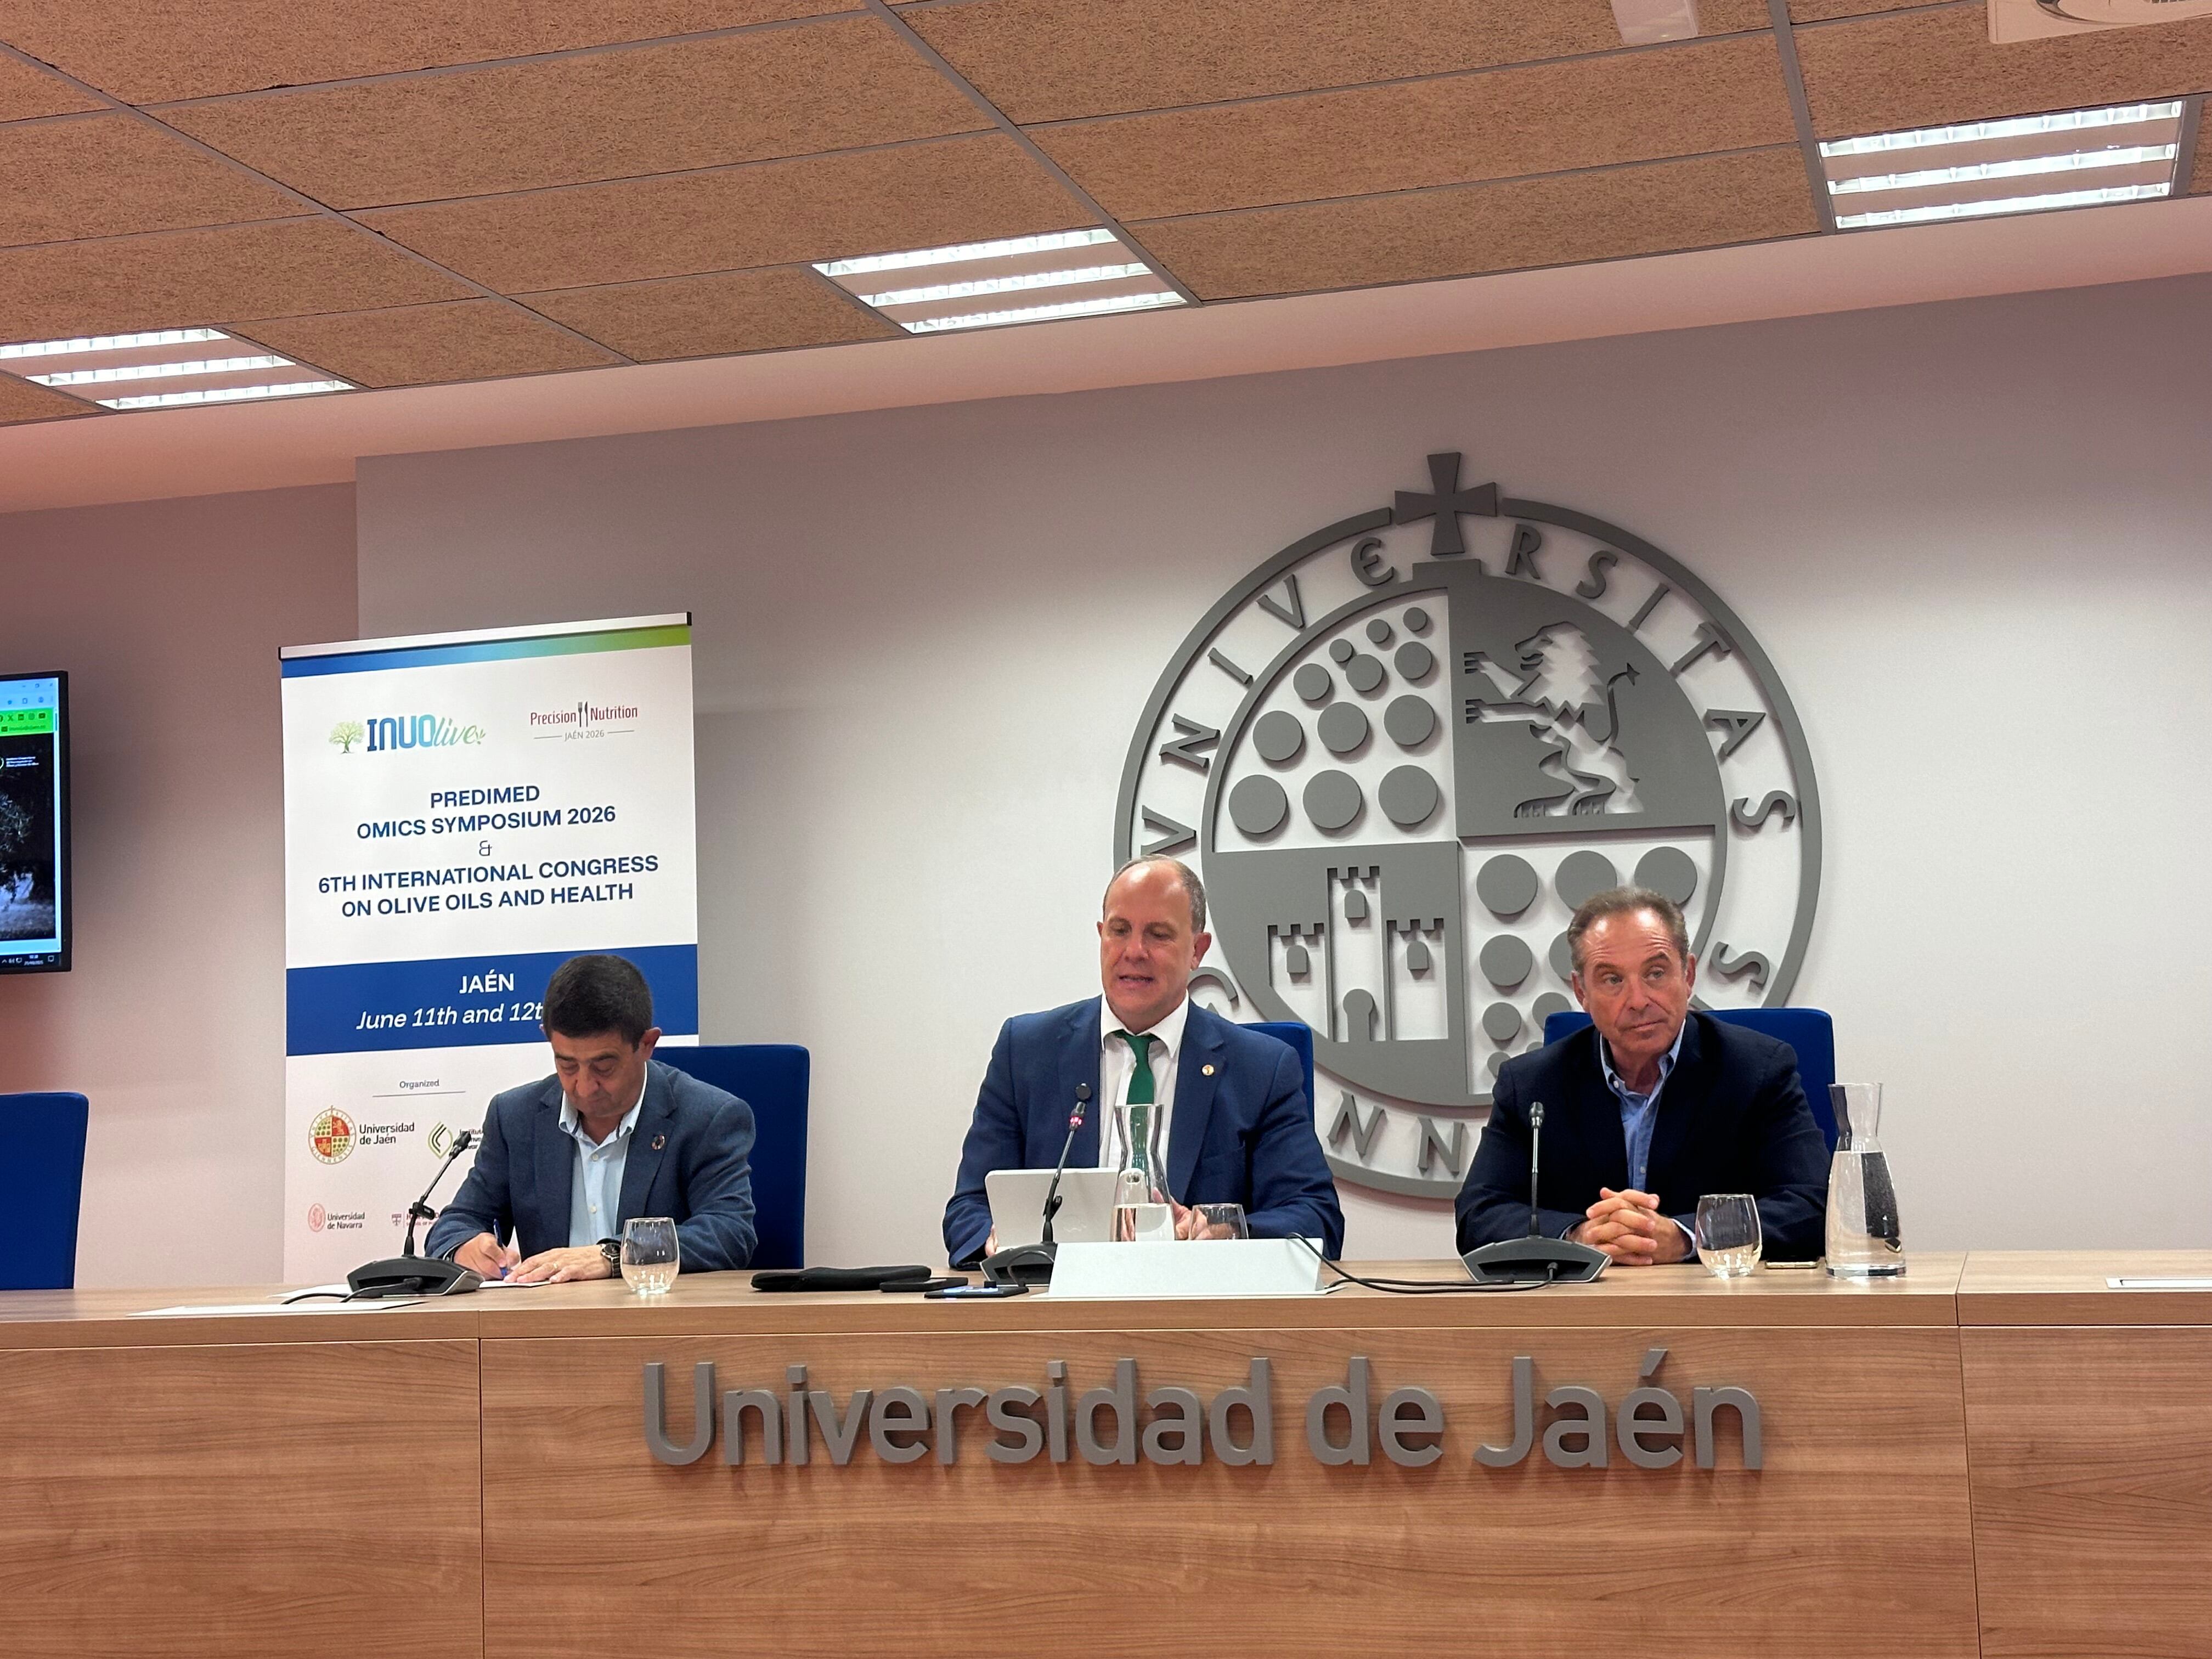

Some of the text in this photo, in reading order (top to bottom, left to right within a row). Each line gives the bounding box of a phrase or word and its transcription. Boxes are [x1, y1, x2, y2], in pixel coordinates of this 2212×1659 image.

[530, 705, 637, 726] Precision Nutrition
[565, 730, 605, 741] JAÉN 2026
[430, 786, 540, 809] PREDIMED
[357, 806, 616, 839] OMICS SYMPOSIUM 2026
[478, 840, 492, 857] &
[318, 855, 658, 894] 6TH INTERNATIONAL CONGRESS
[341, 883, 633, 917] ON OLIVE OILS AND HEALTH
[459, 969, 514, 994] JAÉN
[356, 1011, 407, 1030] June
[412, 1006, 457, 1027] 11th
[462, 1003, 504, 1024] and
[399, 1079, 439, 1089] Organized
[359, 1121, 415, 1134] Universidad
[359, 1133, 396, 1145] de Jaén
[328, 1212, 365, 1221] Universidad
[643, 1348, 1763, 1470] Universidad de Jaén
